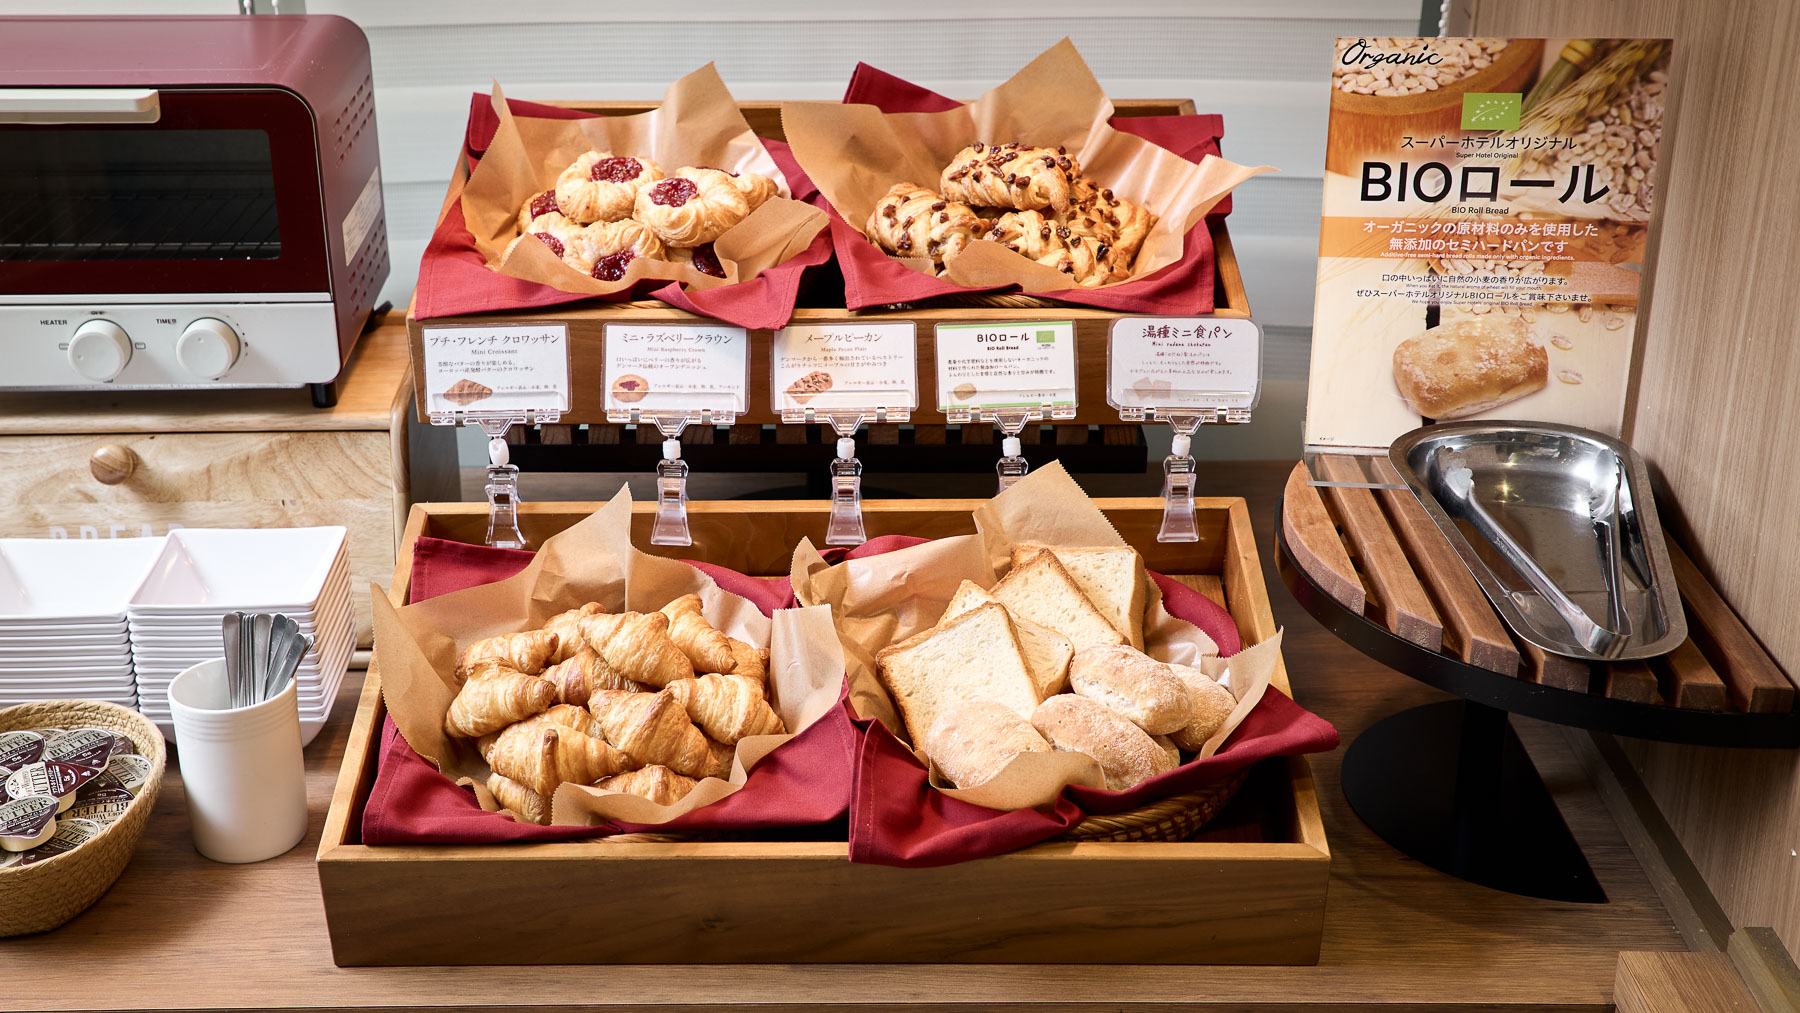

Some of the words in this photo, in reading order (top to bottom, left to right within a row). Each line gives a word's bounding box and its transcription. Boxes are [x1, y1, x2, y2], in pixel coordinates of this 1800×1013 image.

[1342, 38, 1444, 70] Organic
[1402, 135, 1578, 151] スーパーホテルオリジナル
[1360, 161, 1610, 205] BIOロール
[1451, 206, 1466, 214] BIO
[1468, 206, 1484, 214] Roll
[1485, 206, 1509, 215] Bread
[1363, 220, 1599, 237] オーガニックの原材料のみを使用した
[1389, 236, 1569, 253] 無添加のセミハードパンです
[1382, 273, 1568, 286] 口の中いっぱいに自然の小麦の香りが広がります。
[621, 332, 734, 345] ミニ・ラズベリークラウン
[804, 332, 883, 344] メープルピーカン
[976, 332, 1030, 343] BIOロール
[1142, 324, 1233, 340] 湯種ミニ食パン
[429, 335, 498, 348] プチ・フレンチ
[502, 333, 560, 345] クロワッサン
[49, 732, 104, 757] BUTTER
[71, 801, 129, 819] BUTTER
